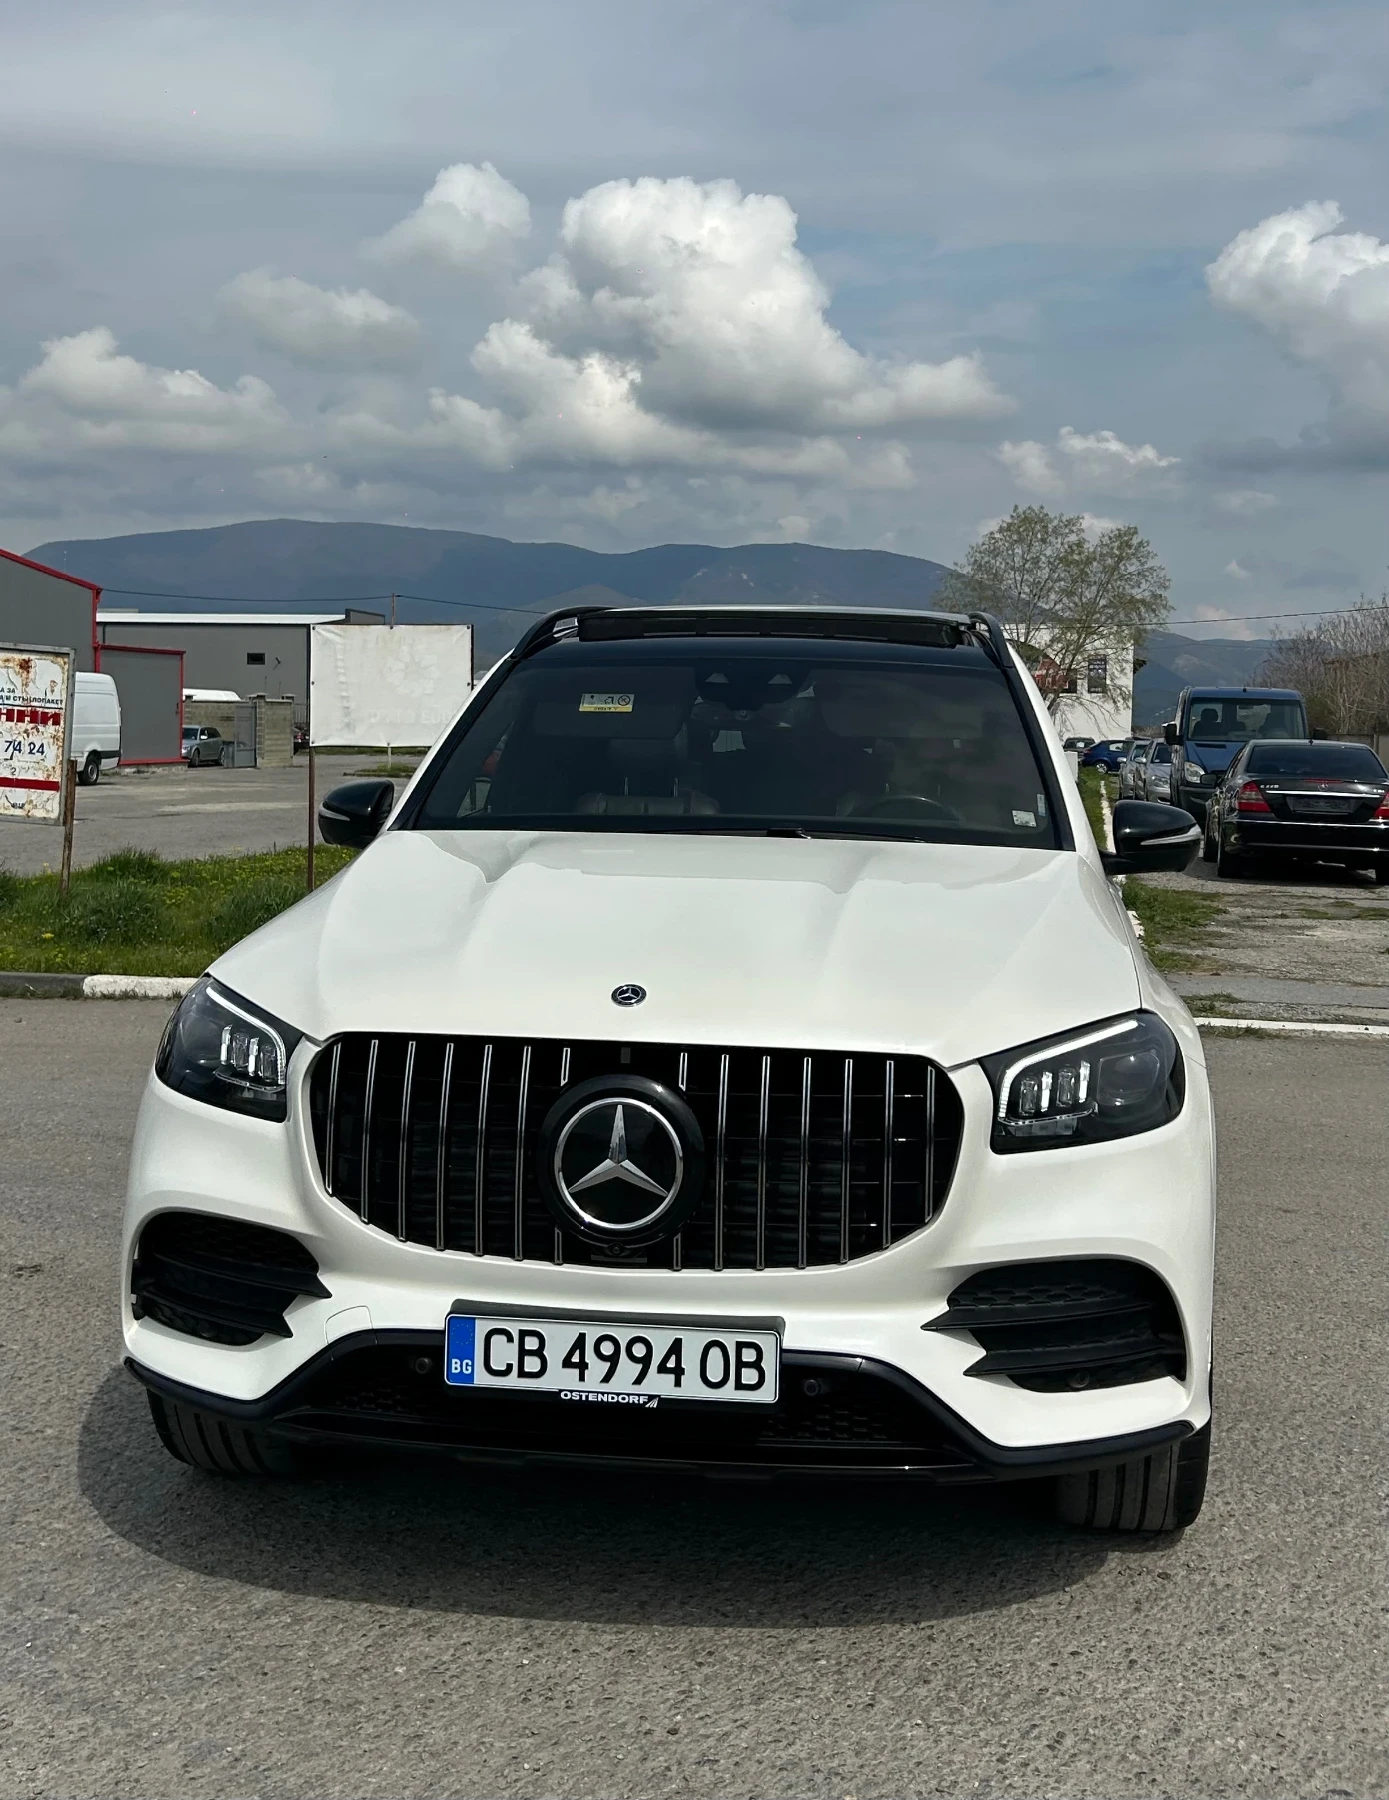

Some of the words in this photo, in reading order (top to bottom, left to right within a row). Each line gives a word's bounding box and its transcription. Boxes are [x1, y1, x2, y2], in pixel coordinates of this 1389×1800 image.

[28, 742, 45, 756] 24
[451, 1358, 472, 1375] BG
[483, 1327, 548, 1379] CB
[561, 1332, 686, 1388] 4994
[699, 1339, 766, 1391] OB
[560, 1390, 649, 1405] OSTENDORF
